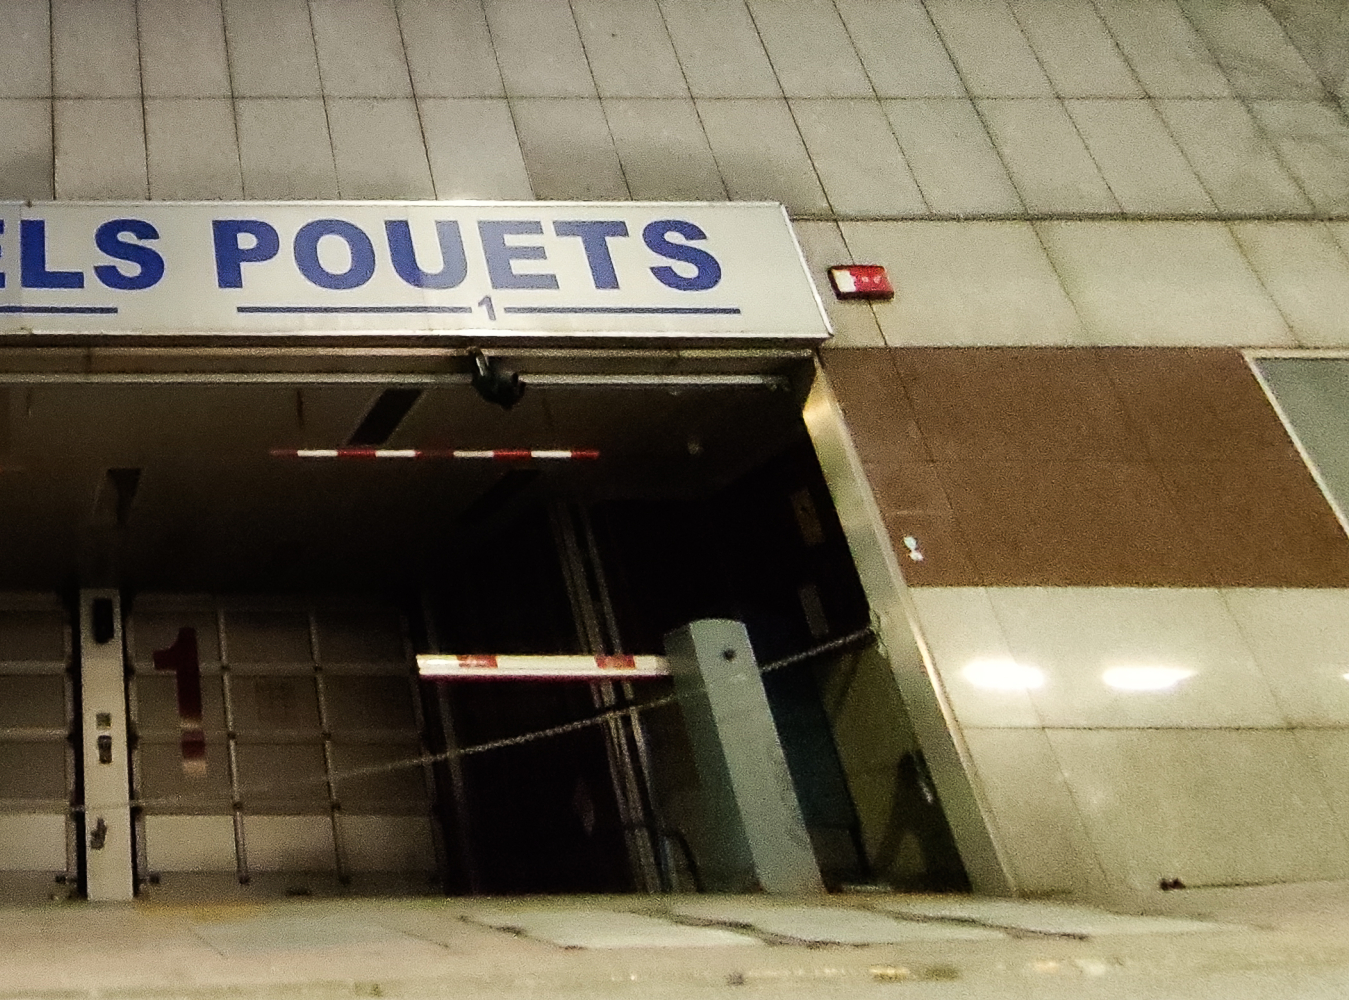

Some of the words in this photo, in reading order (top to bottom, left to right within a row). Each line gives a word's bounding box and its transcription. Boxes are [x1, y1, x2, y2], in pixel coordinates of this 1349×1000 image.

[212, 218, 722, 291] POUETS
[477, 296, 496, 321] 1
[154, 627, 208, 777] 1
